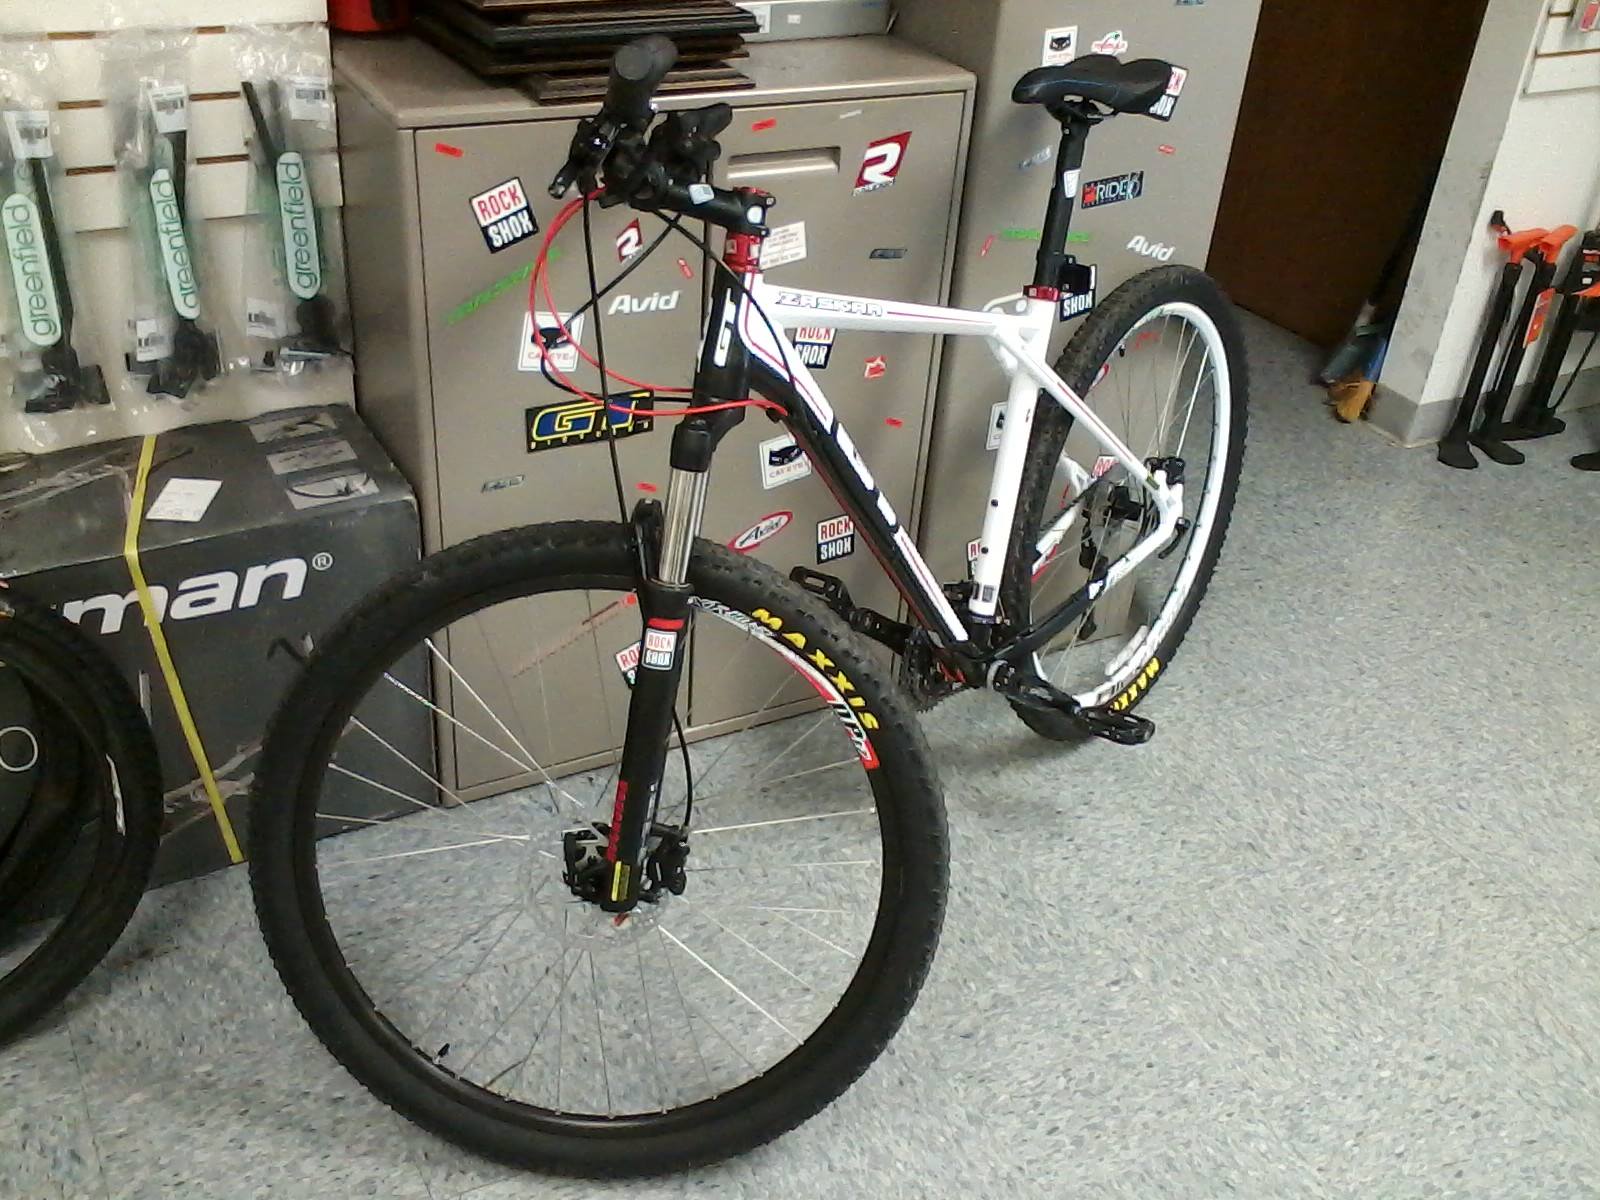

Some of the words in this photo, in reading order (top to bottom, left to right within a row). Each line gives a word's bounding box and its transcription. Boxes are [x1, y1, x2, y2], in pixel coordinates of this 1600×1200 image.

[477, 184, 523, 222] ROCK
[280, 161, 318, 289] greenfield
[487, 209, 535, 248] SHOX
[1125, 235, 1175, 262] Avid
[5, 203, 57, 337] greenfield
[607, 290, 681, 315] Avid
[1063, 295, 1093, 317] SHOX
[820, 518, 851, 540] ROCK
[820, 537, 852, 560] SHOX
[647, 634, 672, 649] ROCK
[645, 649, 671, 666] SHOX
[751, 608, 880, 730] MAXXIS
